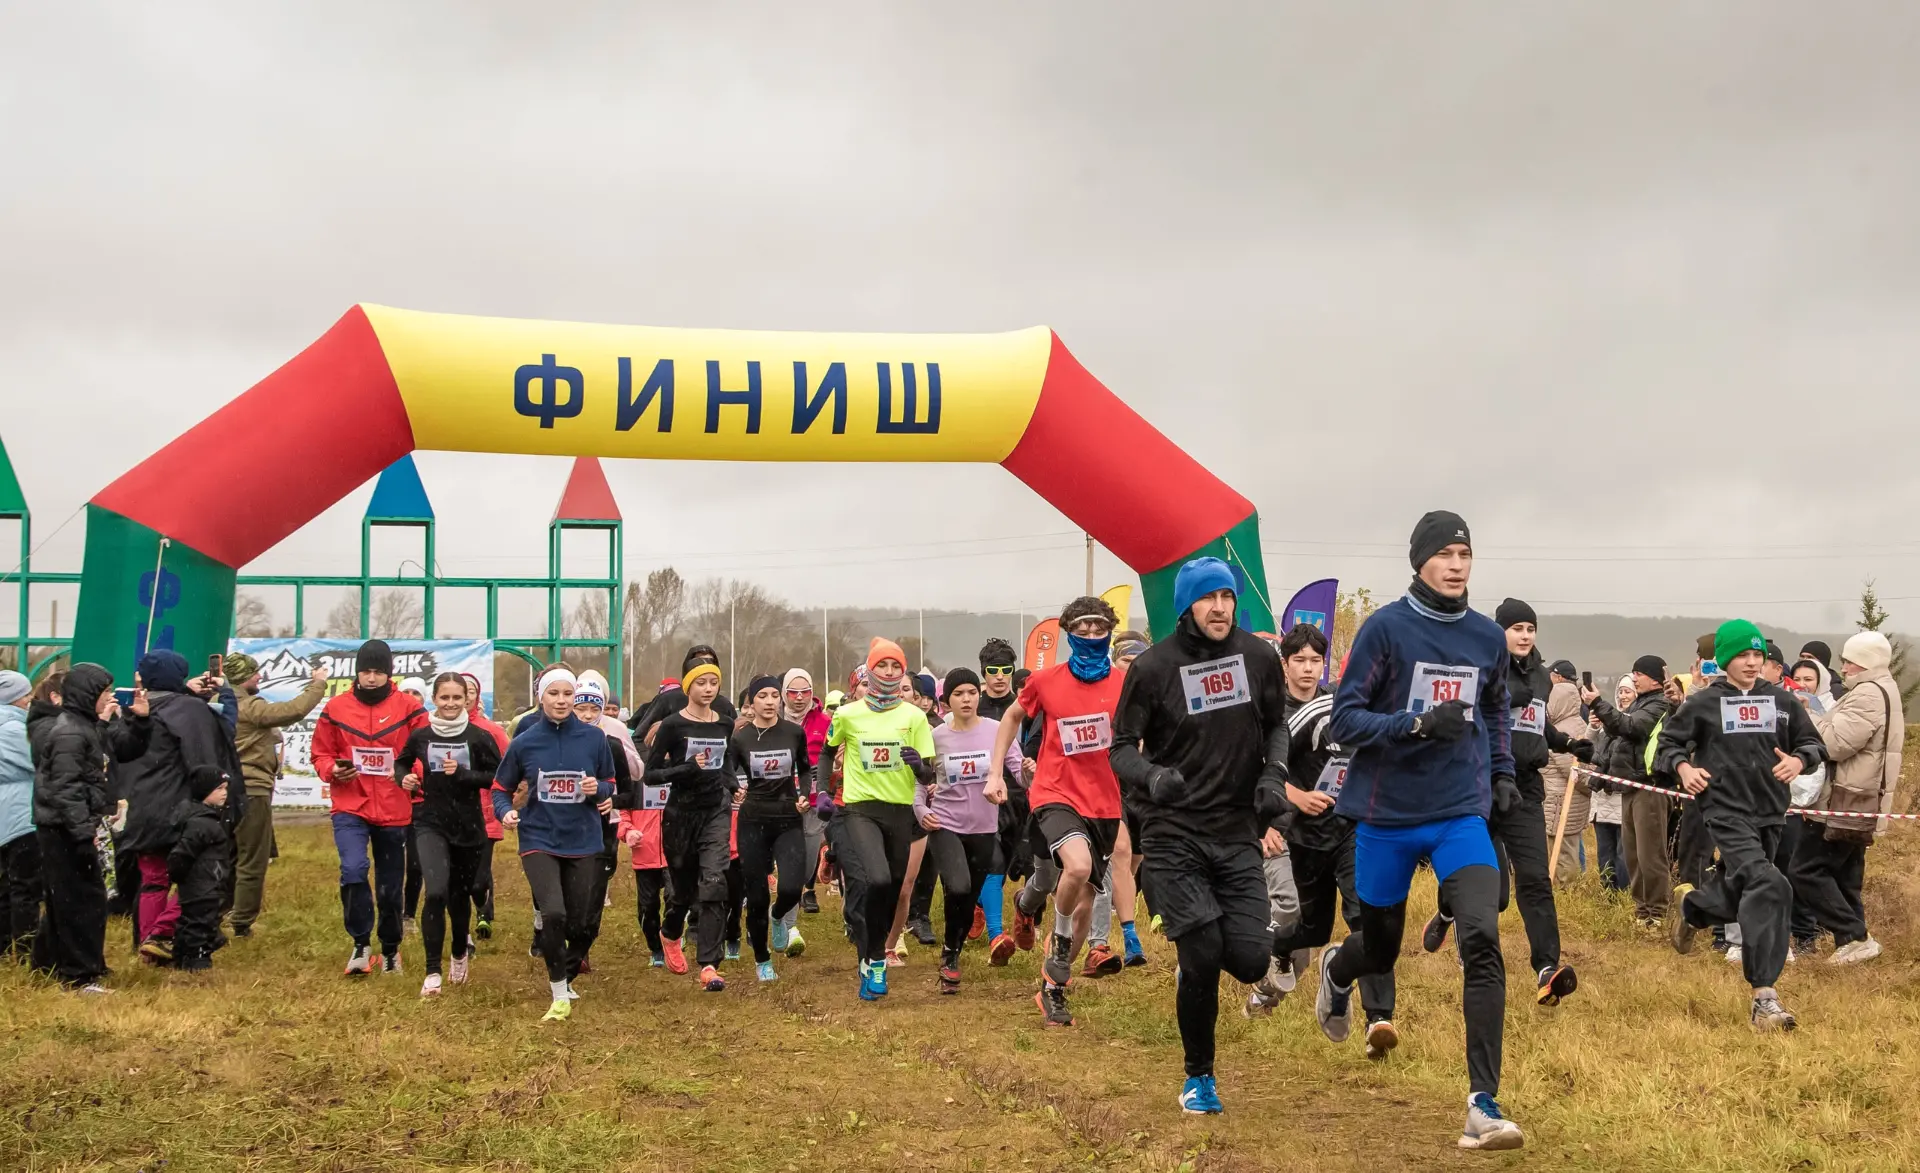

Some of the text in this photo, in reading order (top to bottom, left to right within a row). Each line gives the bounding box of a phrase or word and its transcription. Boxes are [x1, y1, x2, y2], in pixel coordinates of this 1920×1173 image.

[514, 353, 942, 435] ФИНИШ
[1218, 660, 1239, 669] спорта
[1200, 671, 1234, 696] 169
[1432, 679, 1462, 703] 137
[1520, 706, 1536, 721] 28
[1739, 706, 1759, 720] 99
[1074, 725, 1097, 742] 113
[361, 754, 384, 767] 298
[872, 747, 890, 762] 23
[764, 759, 779, 771] 22
[961, 761, 976, 774] 21
[548, 779, 575, 793] 296
[659, 789, 667, 801] 8
